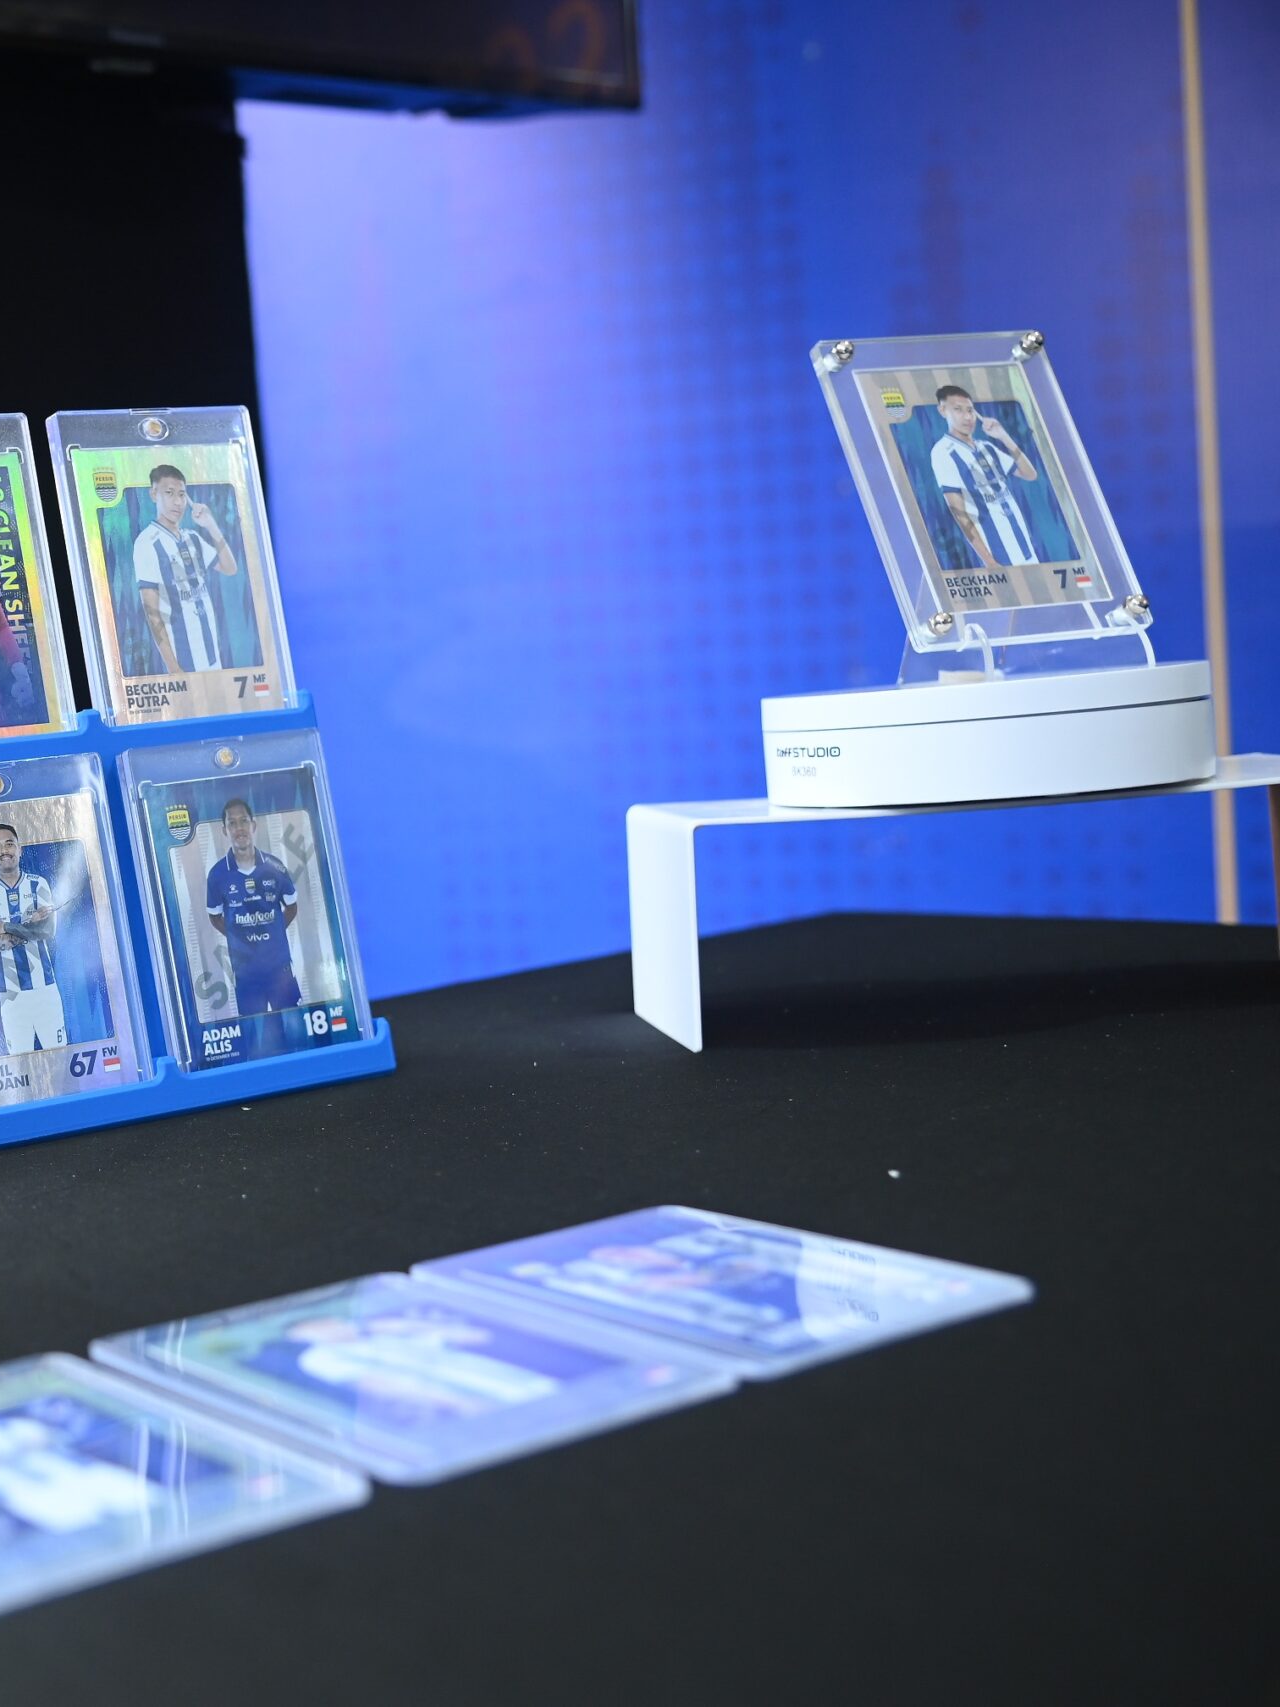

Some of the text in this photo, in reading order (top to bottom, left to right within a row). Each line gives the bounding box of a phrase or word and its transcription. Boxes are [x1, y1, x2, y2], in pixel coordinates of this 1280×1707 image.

[945, 573, 1008, 588] BECKHAM
[1053, 567, 1086, 589] 7 MF
[949, 586, 992, 599] PUTRA
[125, 681, 188, 697] BECKHAM
[233, 673, 266, 699] 7 MF
[127, 695, 170, 709] PUTRA
[235, 909, 275, 926] Indofood
[246, 933, 270, 942] vivo
[303, 1005, 343, 1036] 18 MF
[202, 1025, 241, 1043] ADAM
[204, 1040, 233, 1056] ALIS
[70, 1045, 118, 1078] 67 FW
